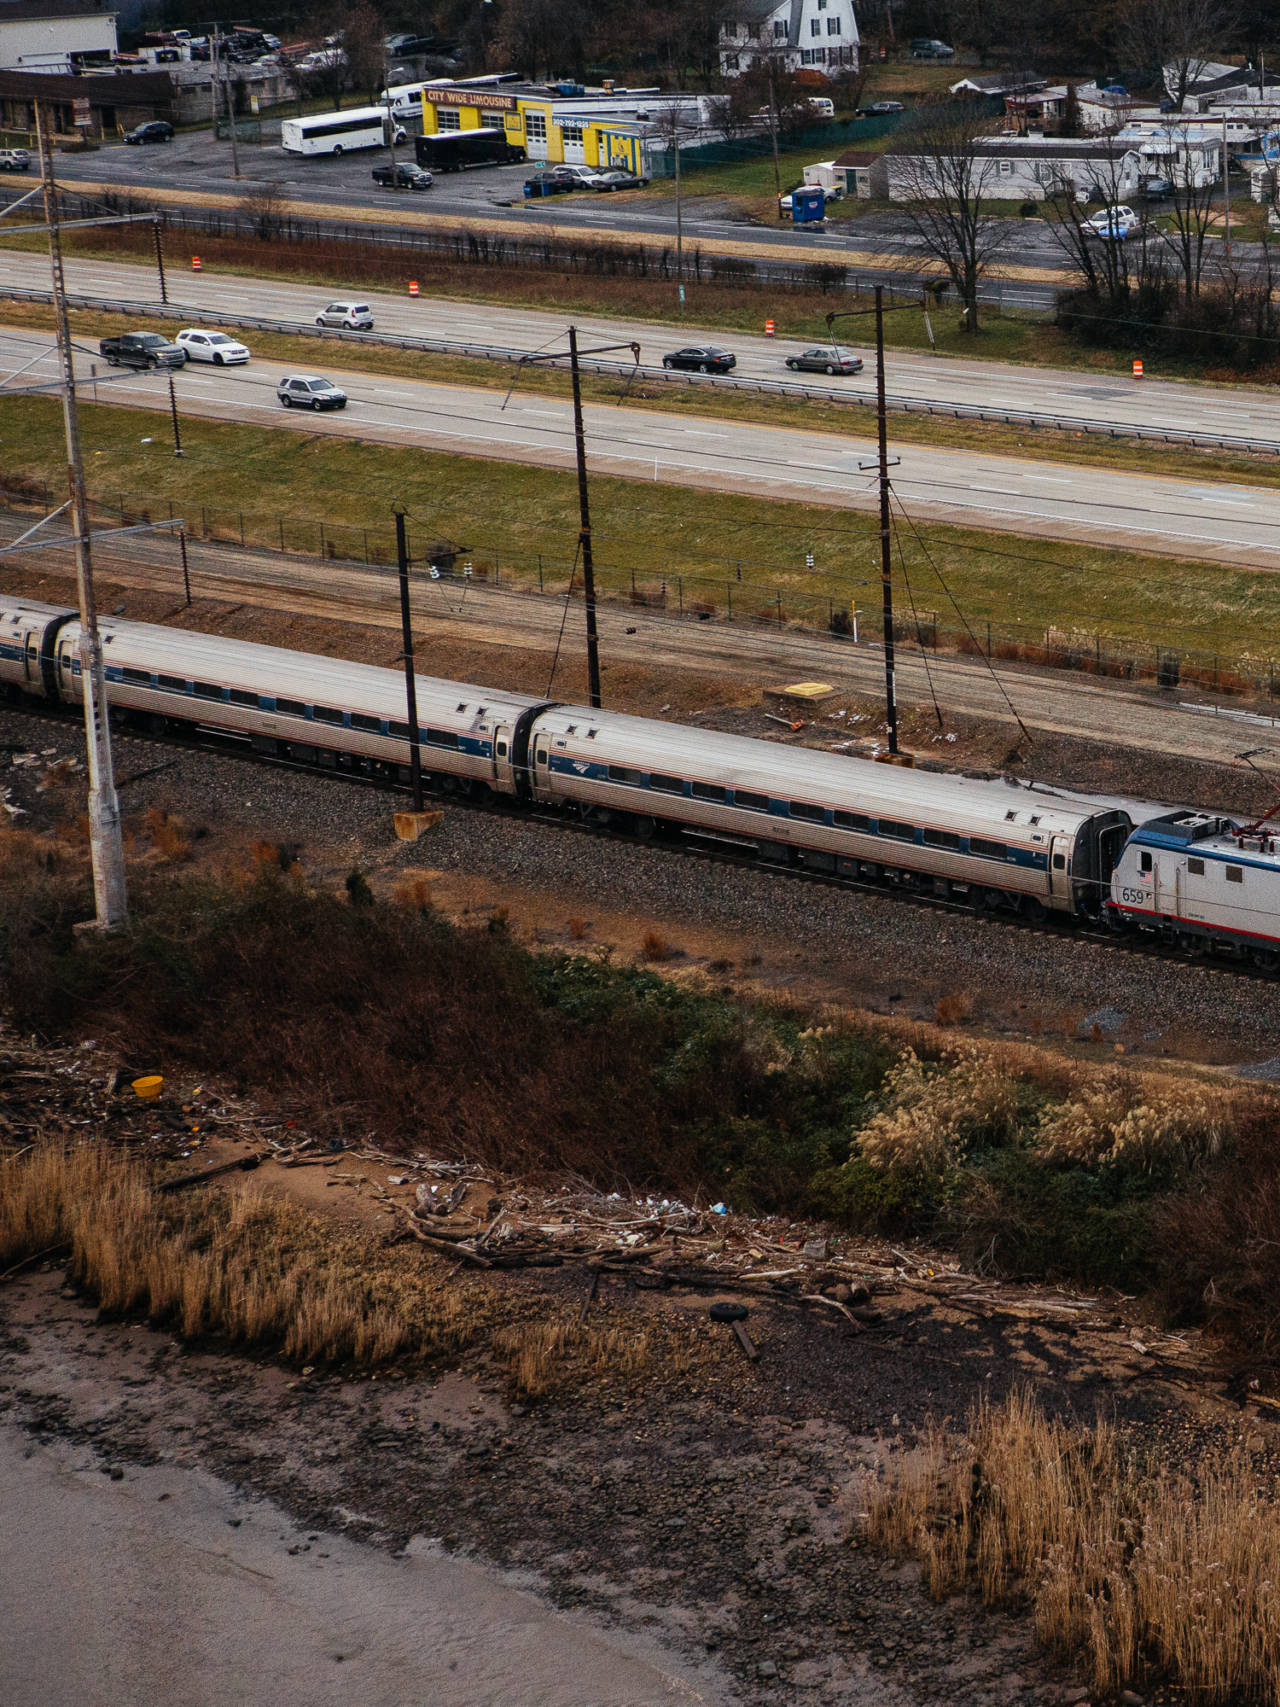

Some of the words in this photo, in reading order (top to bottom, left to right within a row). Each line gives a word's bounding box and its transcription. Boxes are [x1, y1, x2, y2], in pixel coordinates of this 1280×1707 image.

[428, 90, 444, 101] CITY
[447, 92, 467, 103] WIDE
[470, 94, 512, 108] LIMOUSINE
[1122, 888, 1144, 904] 659
